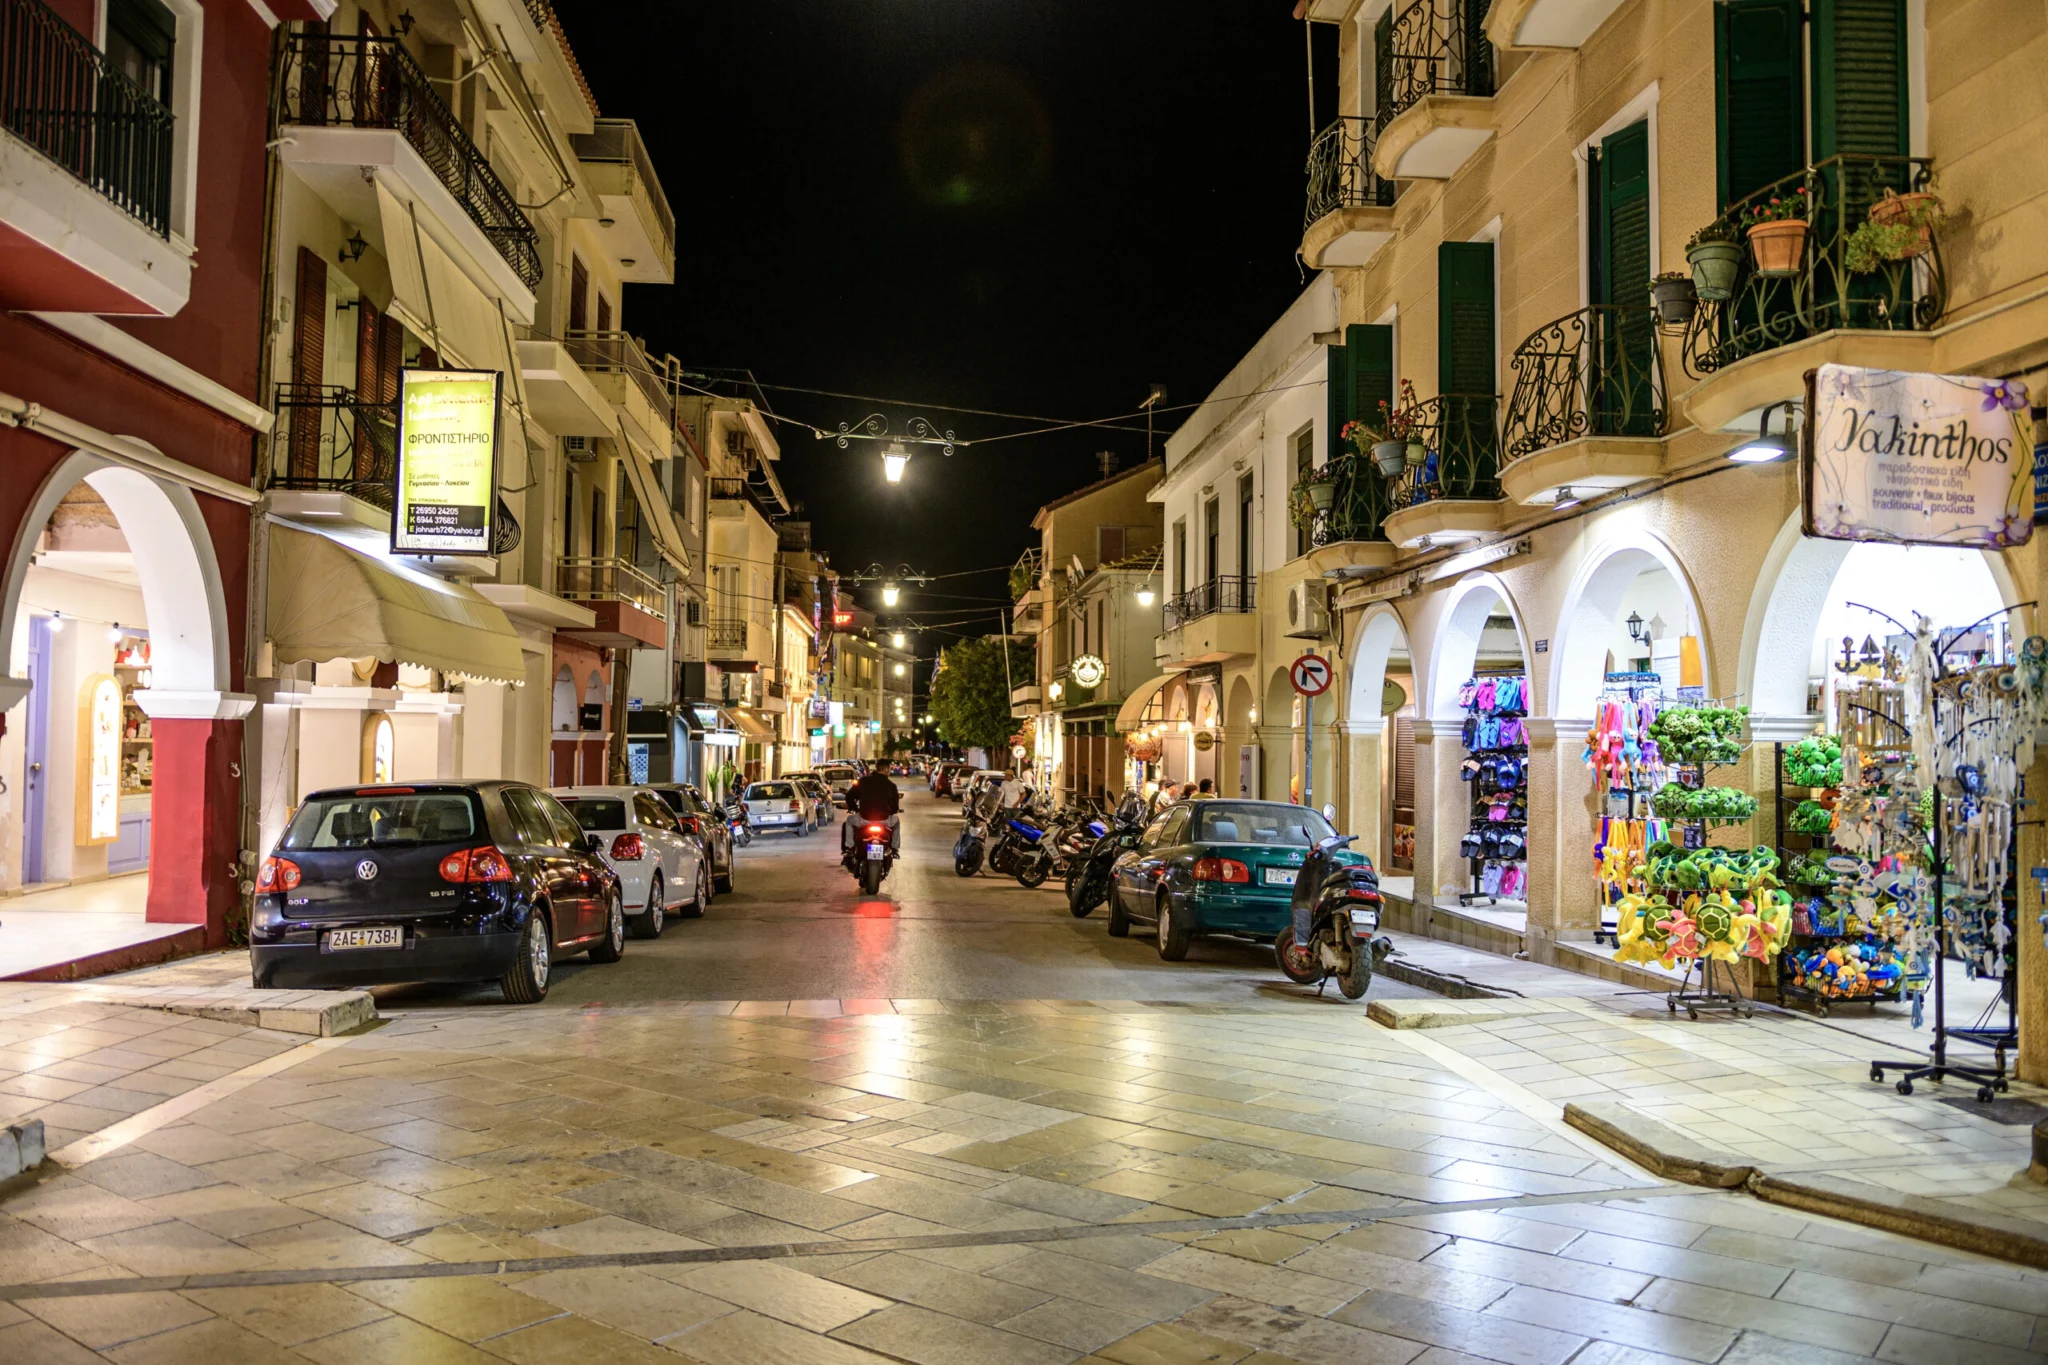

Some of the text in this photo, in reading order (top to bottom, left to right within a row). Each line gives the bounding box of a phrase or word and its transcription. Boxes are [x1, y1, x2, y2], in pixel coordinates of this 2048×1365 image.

[408, 433, 490, 445] ΦΡΟΝΤΙΣΤΗΡΙΟ
[1834, 407, 2012, 471] Yakinthos
[1873, 488, 1975, 504] souvenir faux bijoux
[415, 507, 437, 515] 26950
[437, 507, 459, 515] 24205
[1872, 498, 1975, 516] traditional products
[416, 516, 433, 524] 6944
[415, 526, 482, 536] johnarb72@yahoo.gr
